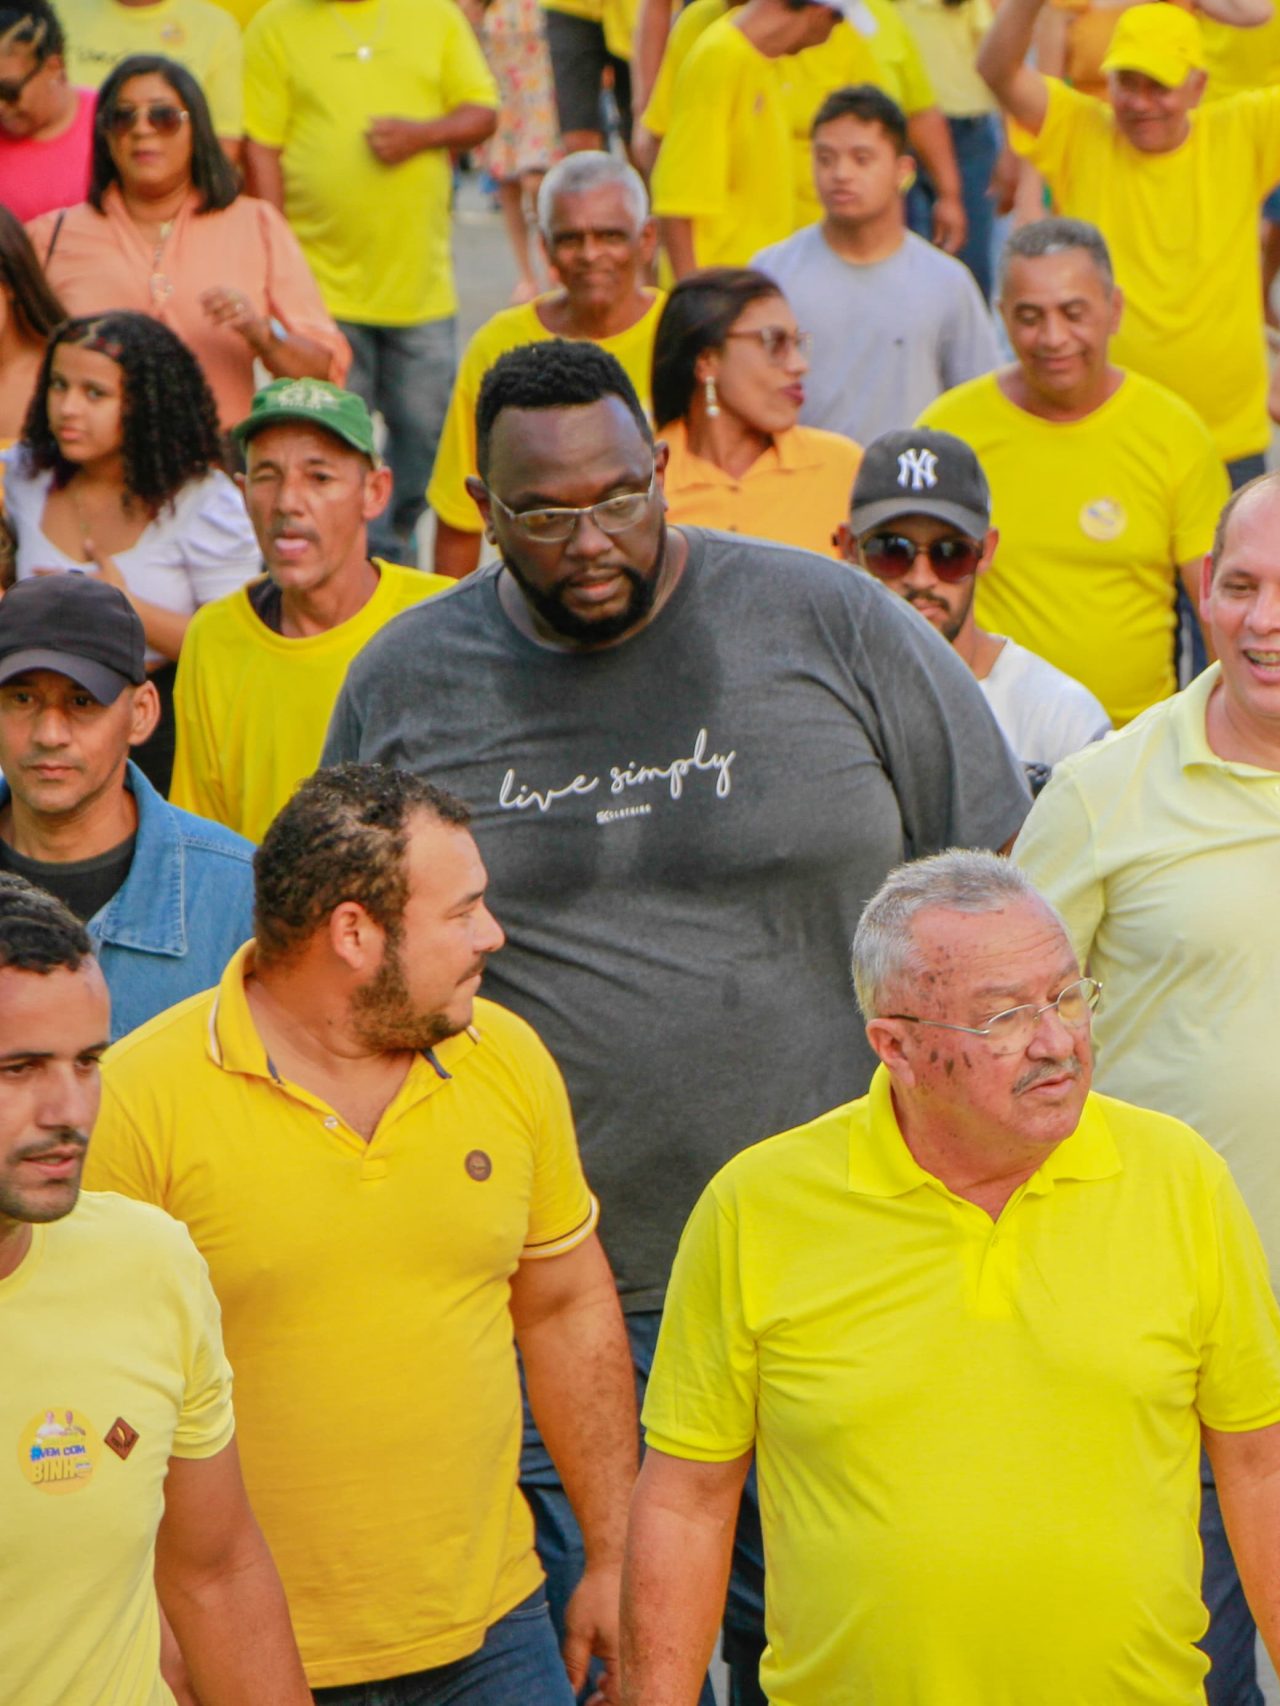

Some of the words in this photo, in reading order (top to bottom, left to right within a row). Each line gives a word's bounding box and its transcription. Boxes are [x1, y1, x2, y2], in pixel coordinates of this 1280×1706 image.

[897, 448, 939, 490] NY
[499, 768, 600, 812] live
[610, 728, 737, 799] simply
